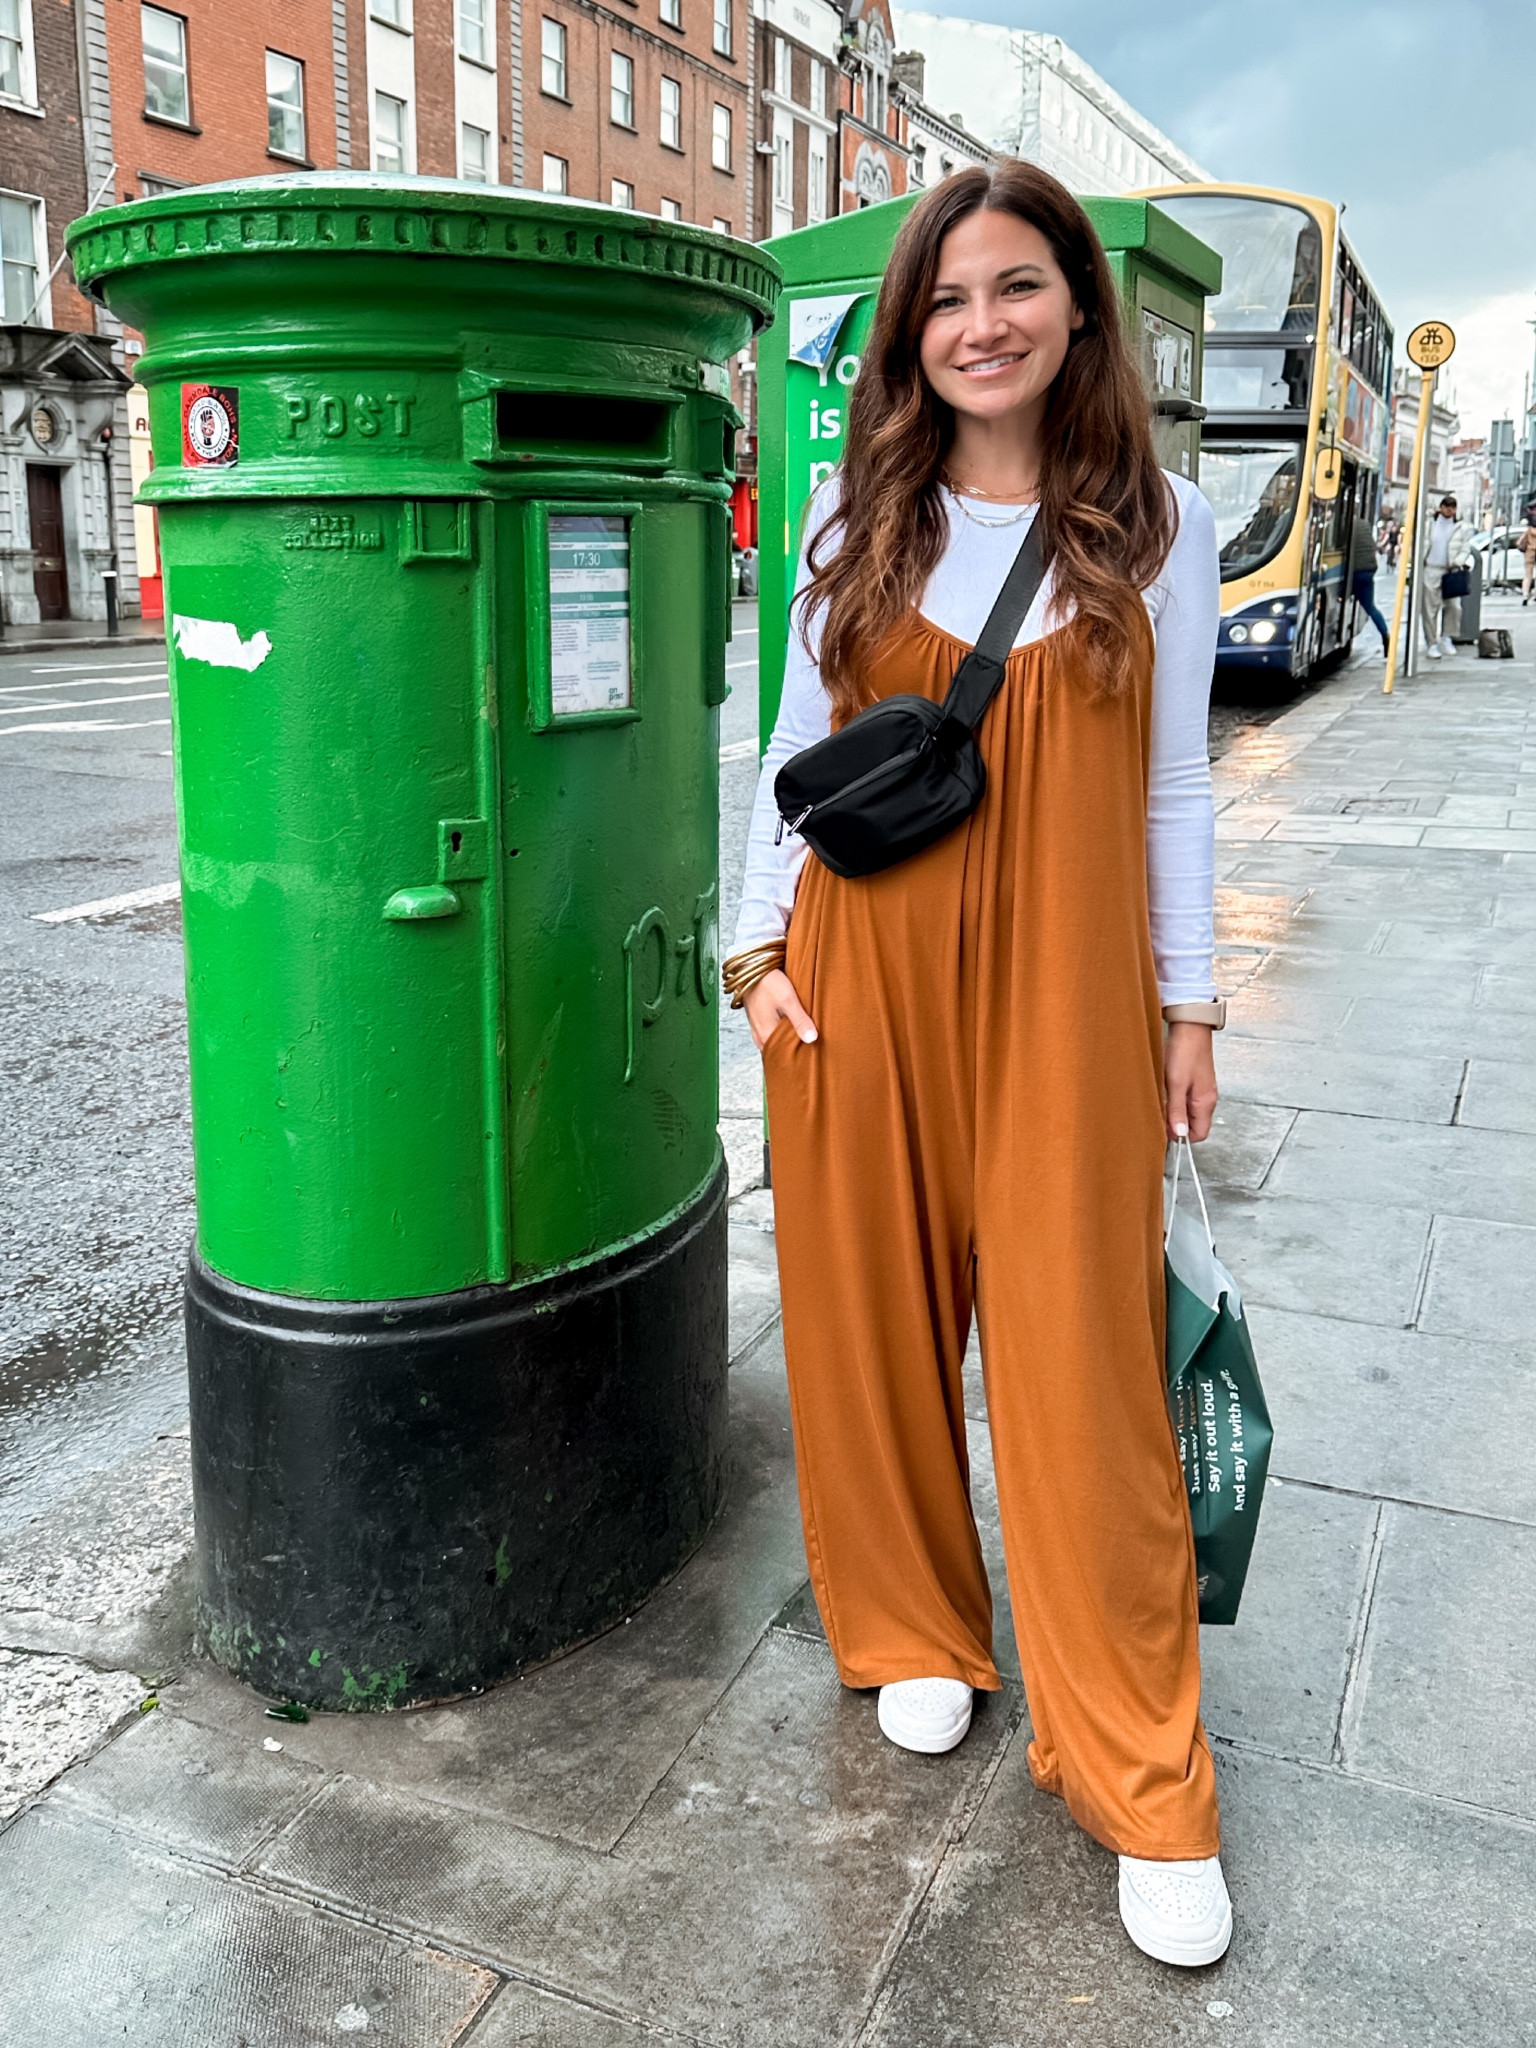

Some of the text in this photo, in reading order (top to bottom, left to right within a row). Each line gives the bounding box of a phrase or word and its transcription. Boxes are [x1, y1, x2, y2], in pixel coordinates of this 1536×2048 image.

[284, 394, 417, 438] POST
[809, 399, 841, 439] is
[308, 515, 355, 532] NEXT
[283, 532, 385, 550] COLLECTION
[573, 552, 601, 567] 17:30
[1229, 1391, 1240, 1401] a
[1228, 1402, 1242, 1438] with
[1191, 1433, 1199, 1459] say
[1200, 1379, 1222, 1493] Say it out loud.
[1230, 1440, 1244, 1453] it
[1191, 1462, 1200, 1494] Just
[1234, 1455, 1248, 1482] say
[1233, 1484, 1246, 1511] And
